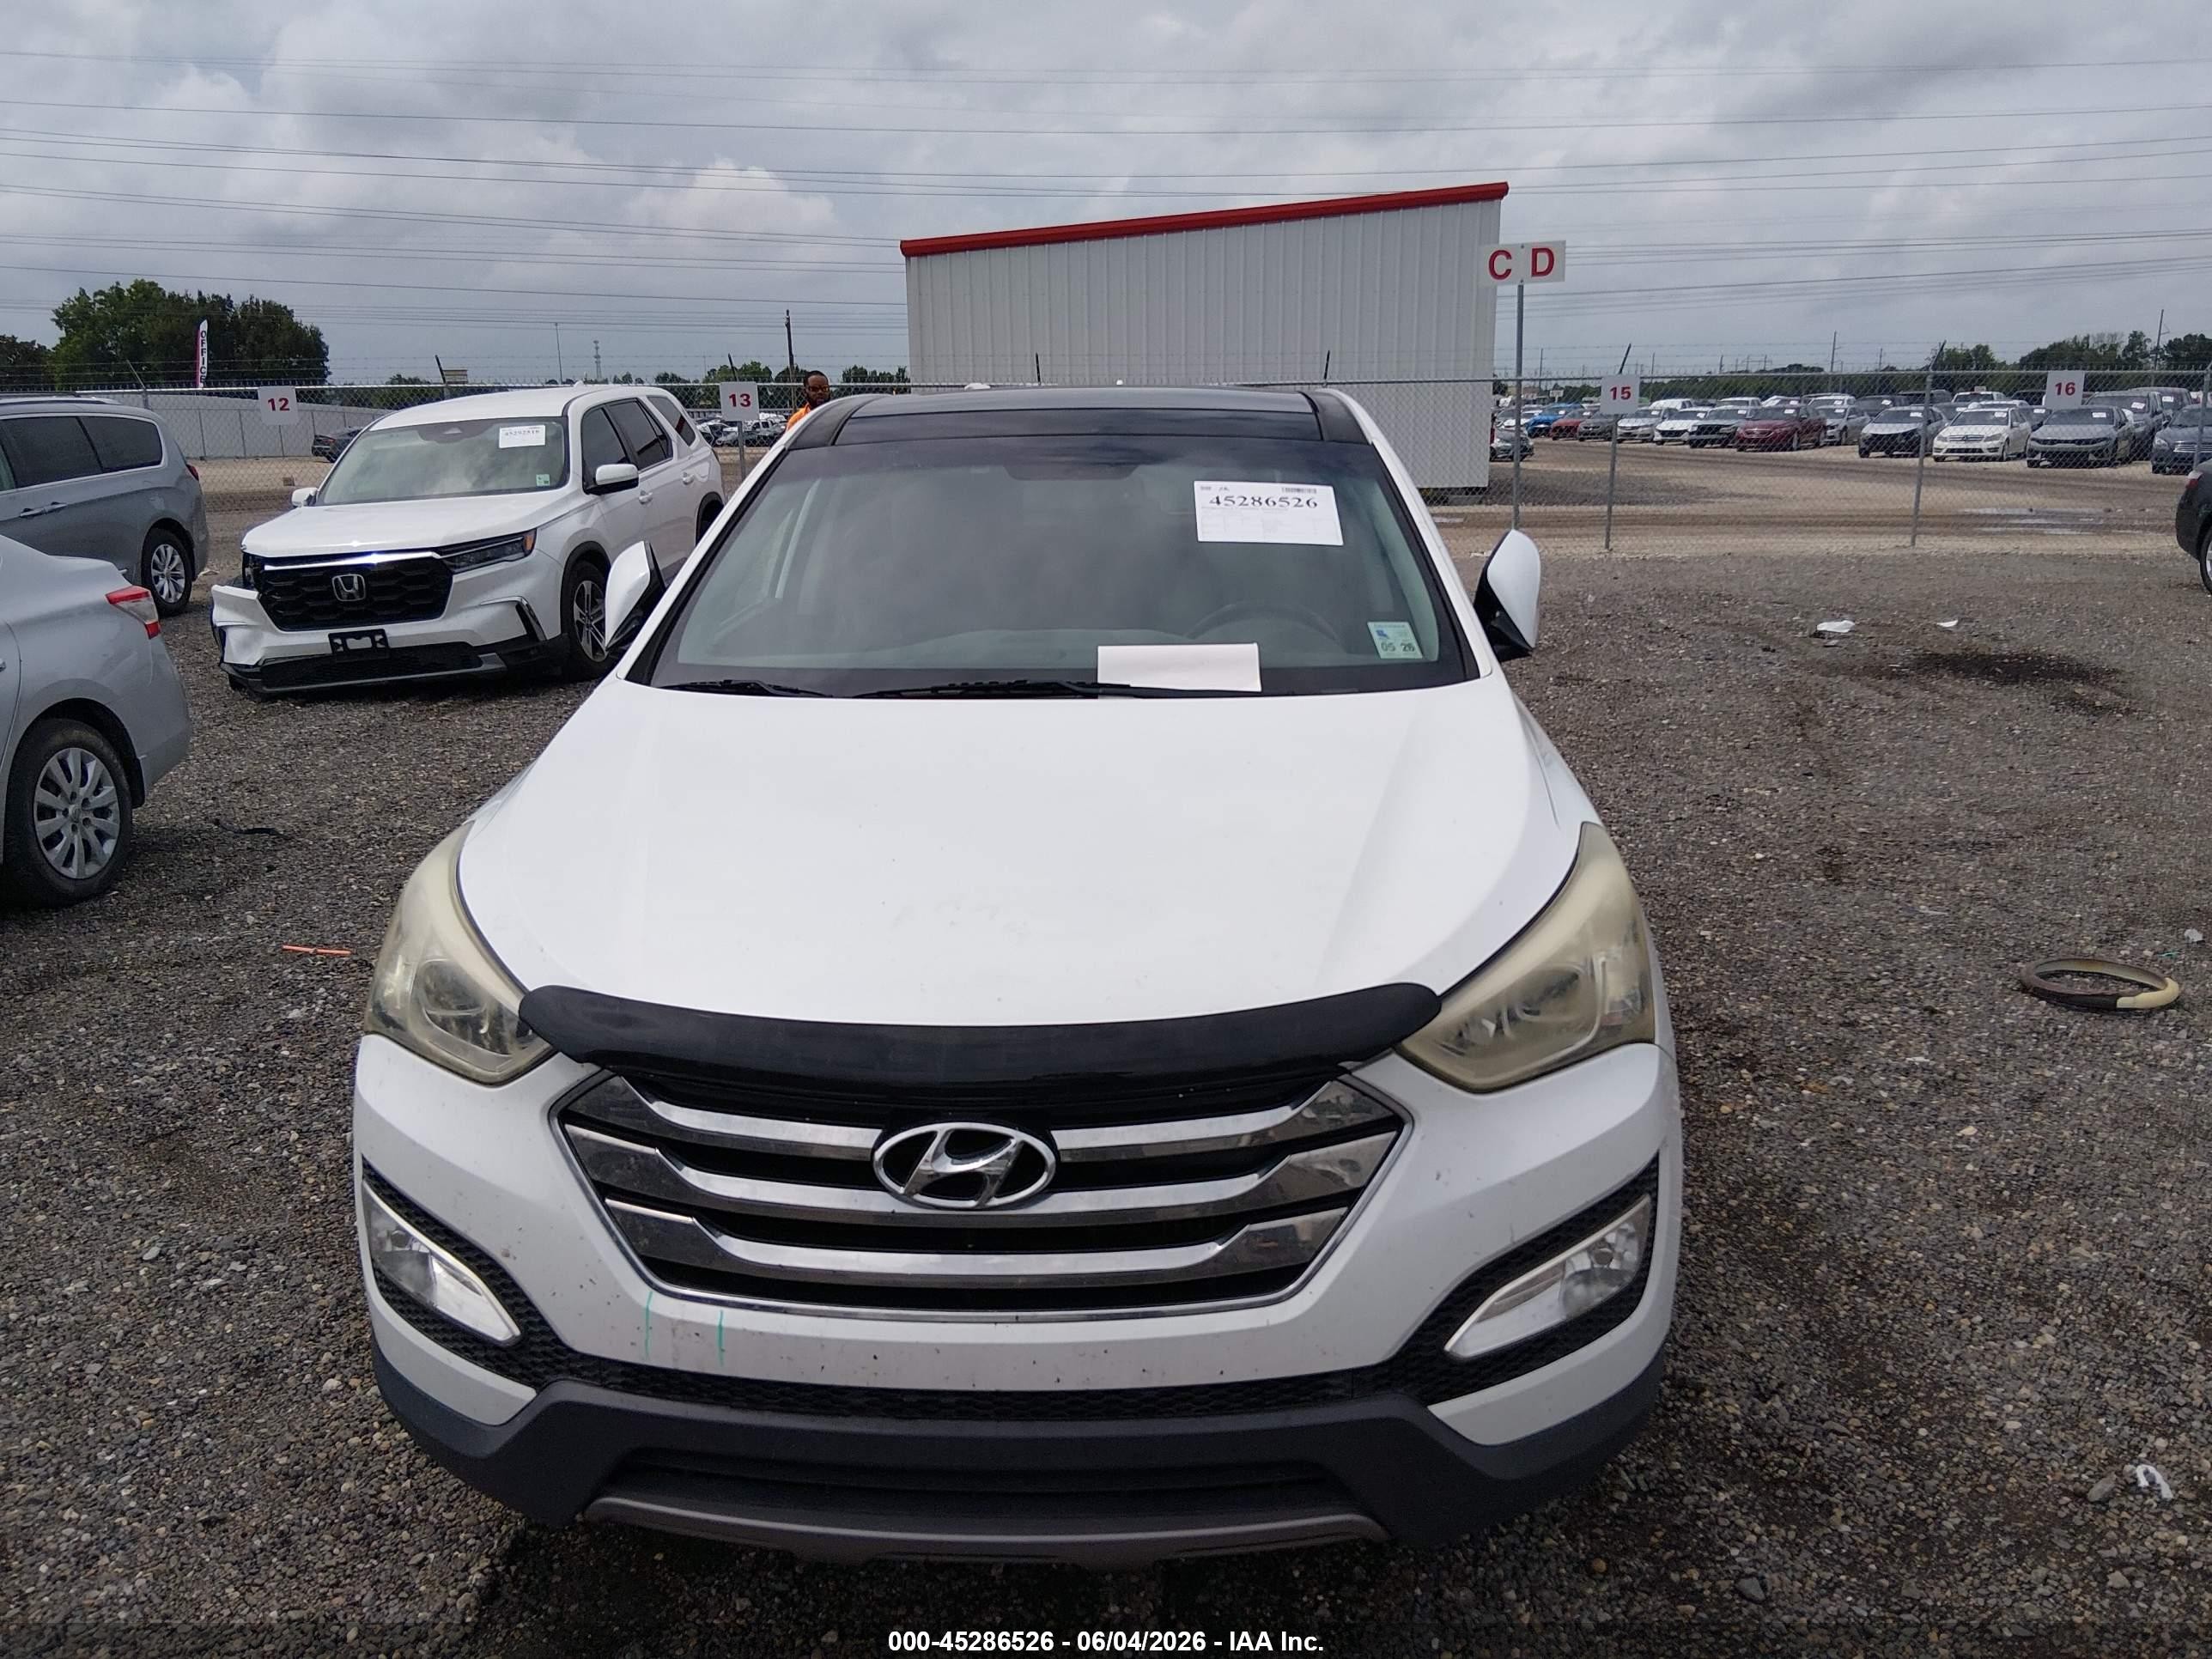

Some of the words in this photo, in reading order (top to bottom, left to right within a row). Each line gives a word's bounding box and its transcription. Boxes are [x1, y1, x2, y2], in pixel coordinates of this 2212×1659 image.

[1488, 249, 1512, 280] C
[1531, 247, 1554, 276] D
[1610, 386, 1632, 400] 15
[2055, 382, 2075, 396] 16
[268, 398, 290, 411] 12
[729, 393, 751, 407] 13
[1209, 495, 1318, 509] 45286526
